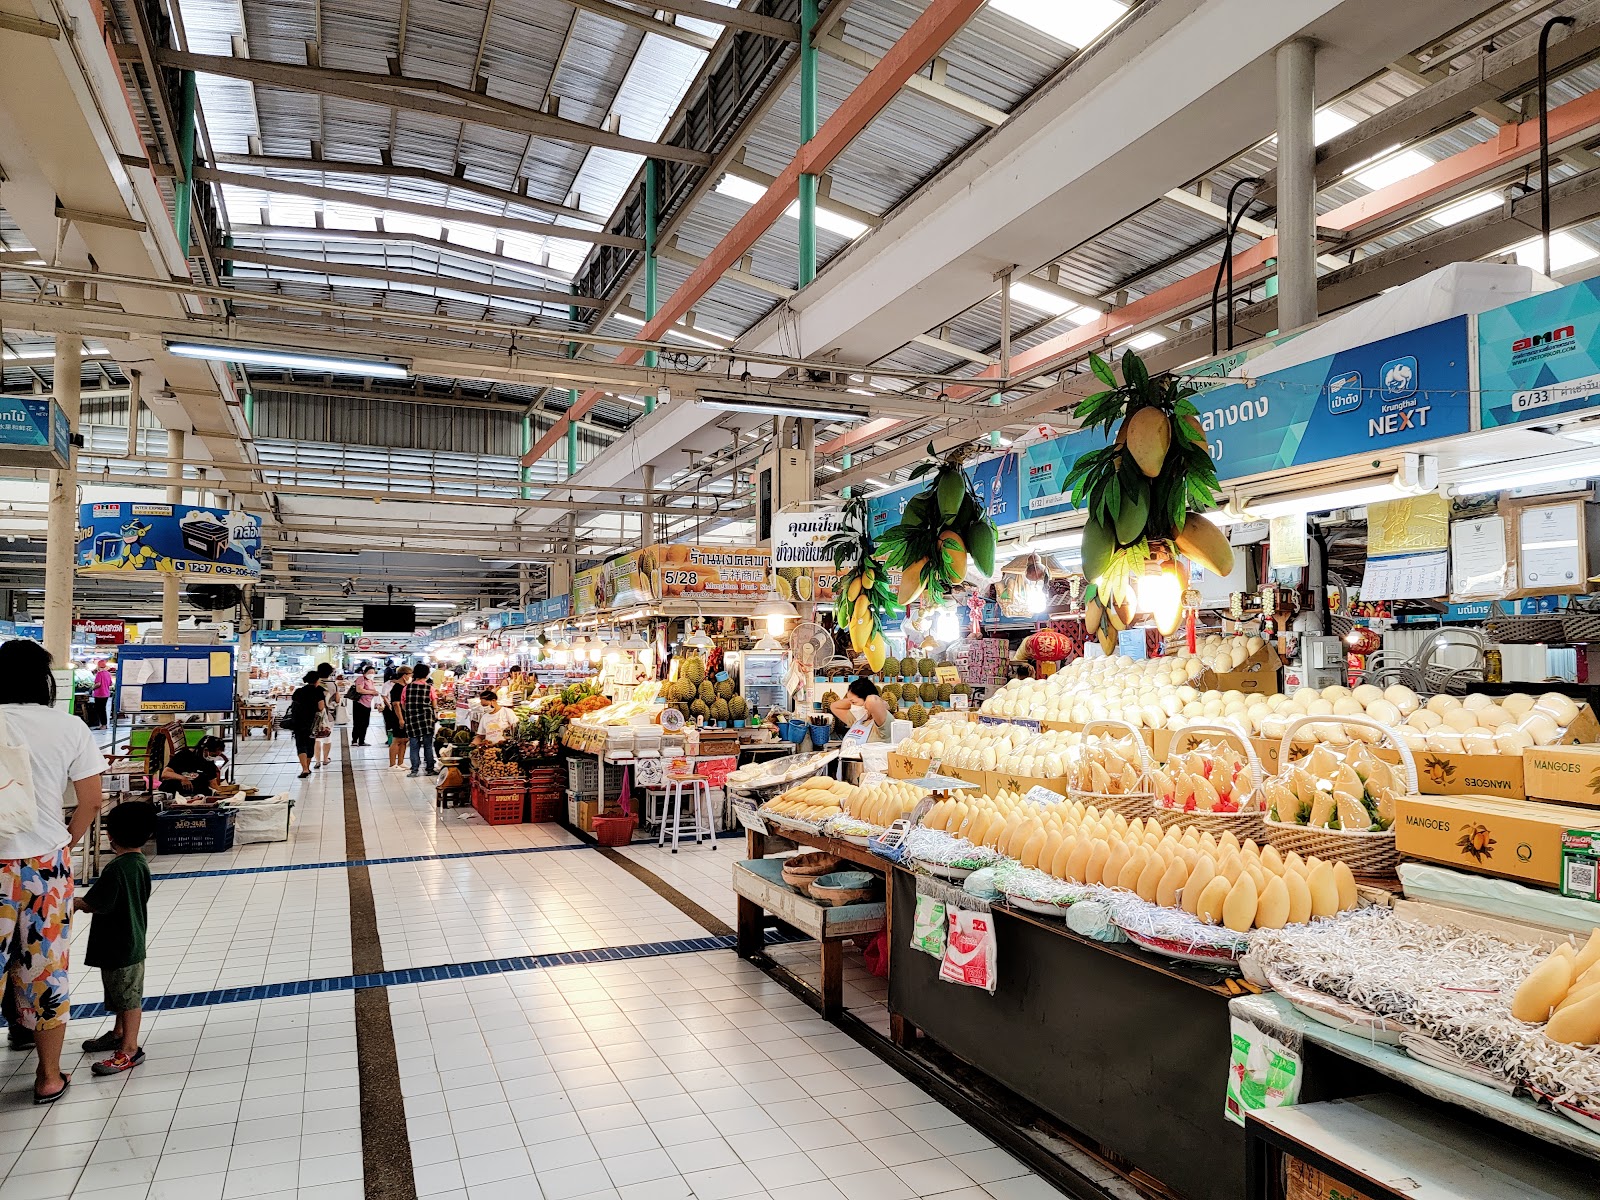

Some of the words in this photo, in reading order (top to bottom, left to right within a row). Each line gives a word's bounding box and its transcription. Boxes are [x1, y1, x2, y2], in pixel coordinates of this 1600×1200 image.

[1381, 398, 1418, 413] Krungthai
[1518, 390, 1549, 407] 6/33
[0, 410, 27, 422] กไม้
[1195, 396, 1270, 432] ลางดง
[1368, 405, 1432, 437] NEXT
[788, 513, 843, 538] คุณเปี๊ย
[690, 548, 773, 567] ร้านมงคลพา
[189, 563, 212, 573] 1297
[665, 571, 698, 585] 5/28
[719, 570, 763, 582] 吉祥商店
[818, 575, 841, 588] 5/2
[140, 701, 186, 711] ประชาสัมพันธ์
[1532, 760, 1582, 774] MANGOES
[1464, 777, 1512, 790] MANGOES
[1406, 815, 1450, 832] MANGOES
